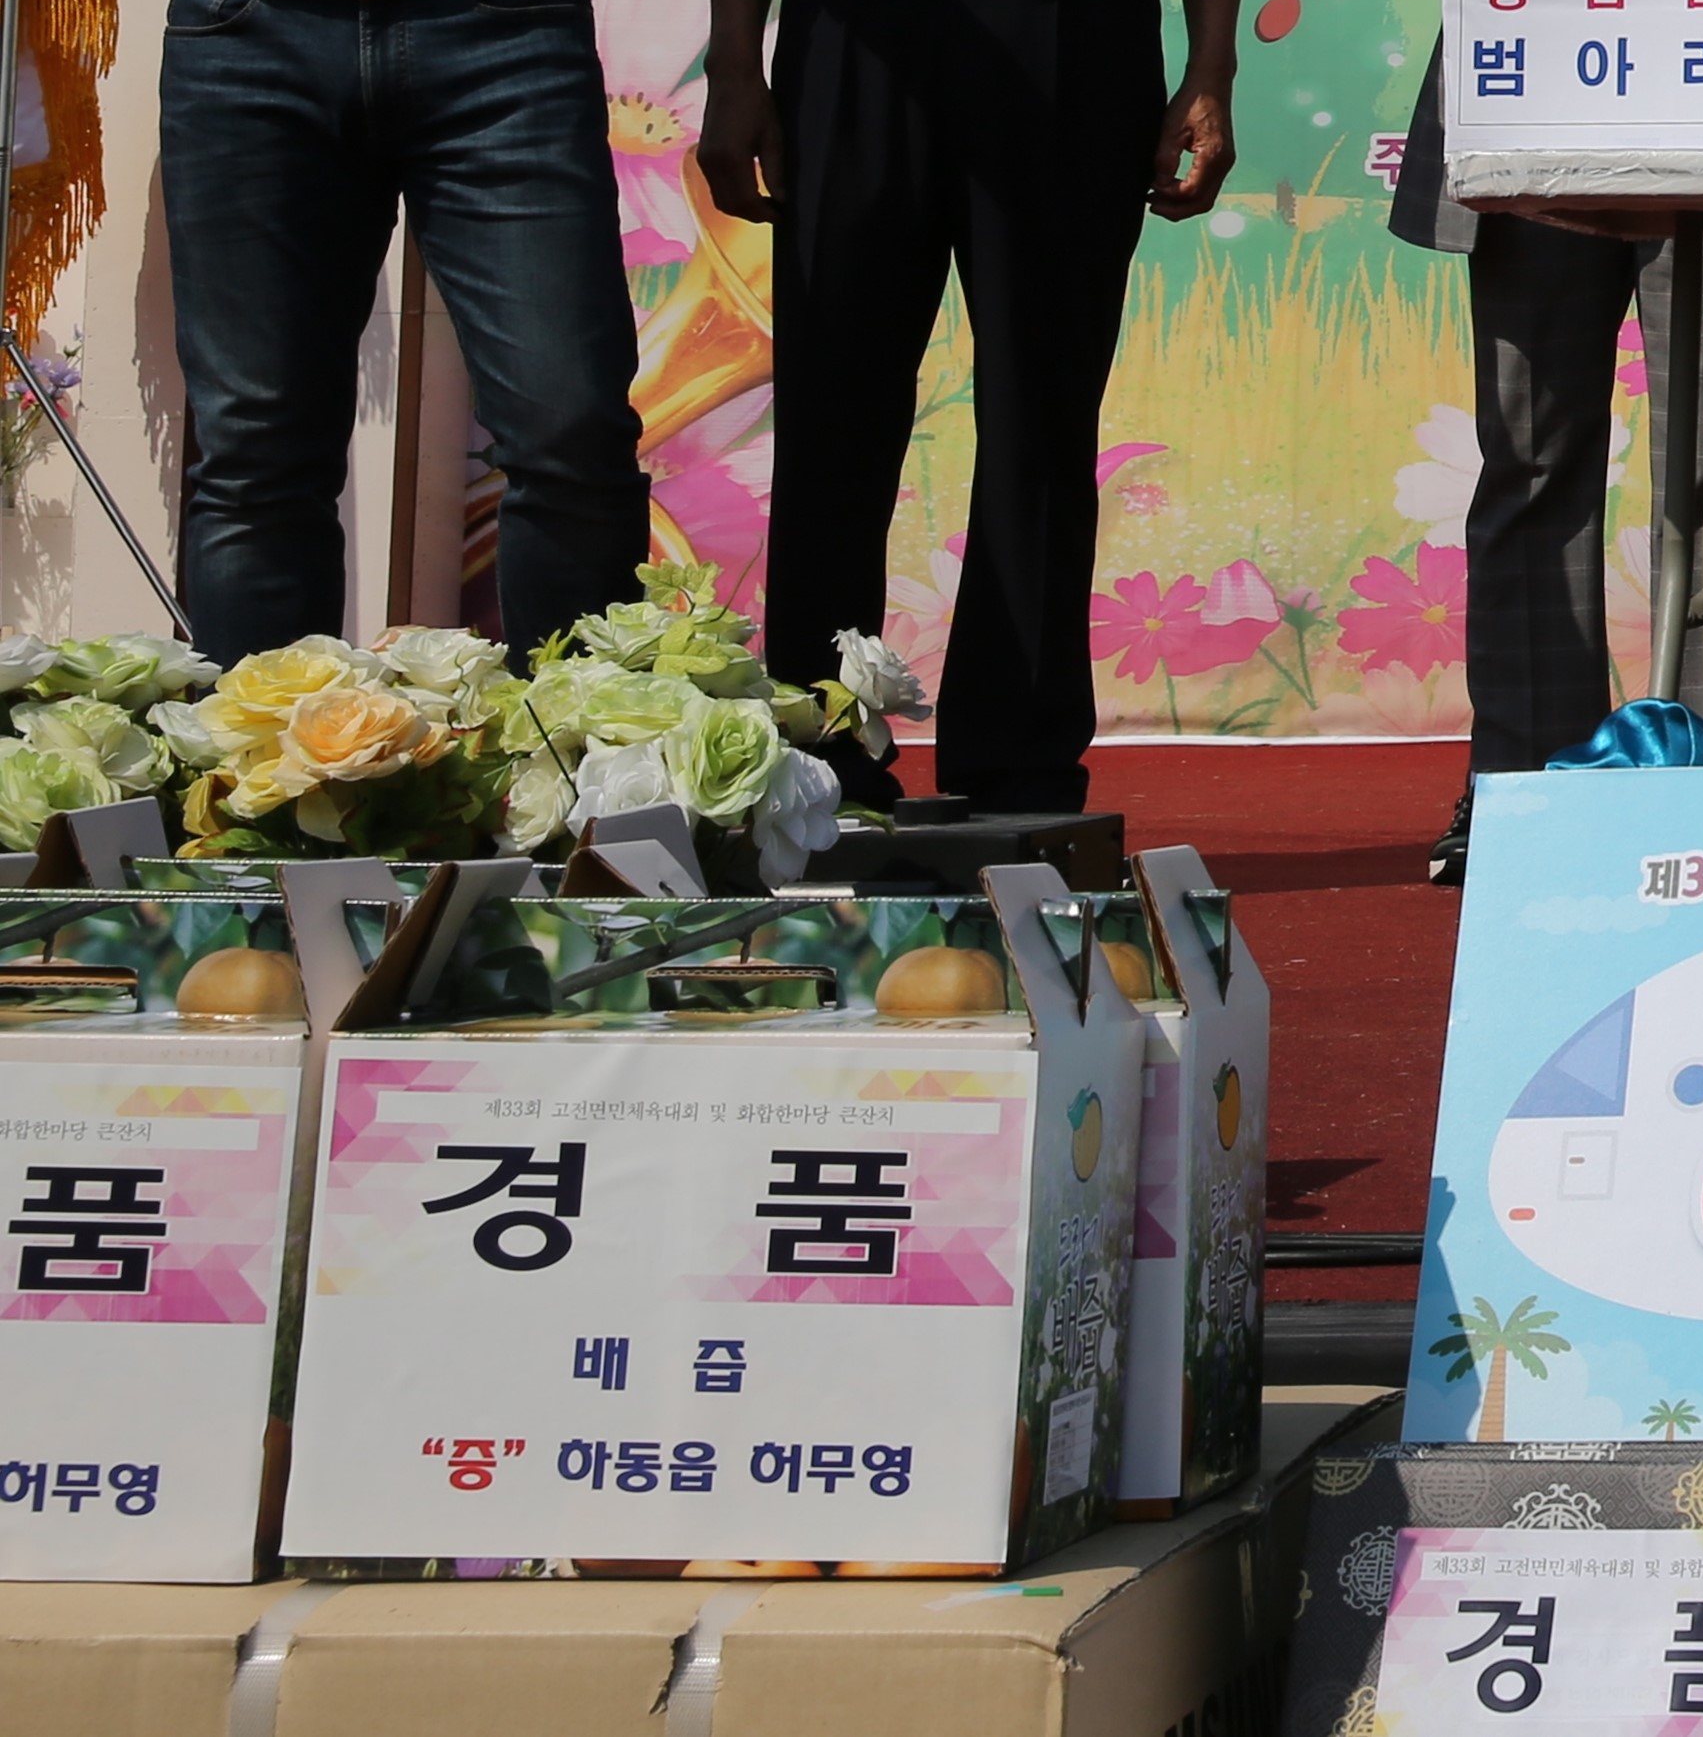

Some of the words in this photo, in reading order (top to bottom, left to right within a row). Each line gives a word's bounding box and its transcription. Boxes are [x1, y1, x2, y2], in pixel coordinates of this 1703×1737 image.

[484, 1099, 542, 1120] 제33회
[551, 1100, 699, 1122] 고전면민체육대회
[710, 1102, 727, 1123] 및
[737, 1103, 830, 1125] 화합한마당
[839, 1104, 894, 1126] 큰잔치
[97, 1121, 153, 1142] 큰잔치
[8, 1166, 167, 1293] 품
[557, 1438, 717, 1493] 하동읍
[750, 1442, 914, 1497] 허무영
[1432, 1558, 1485, 1575] 제33회
[1495, 1558, 1634, 1578] 고전면민체육대회
[1645, 1560, 1659, 1579] 및
